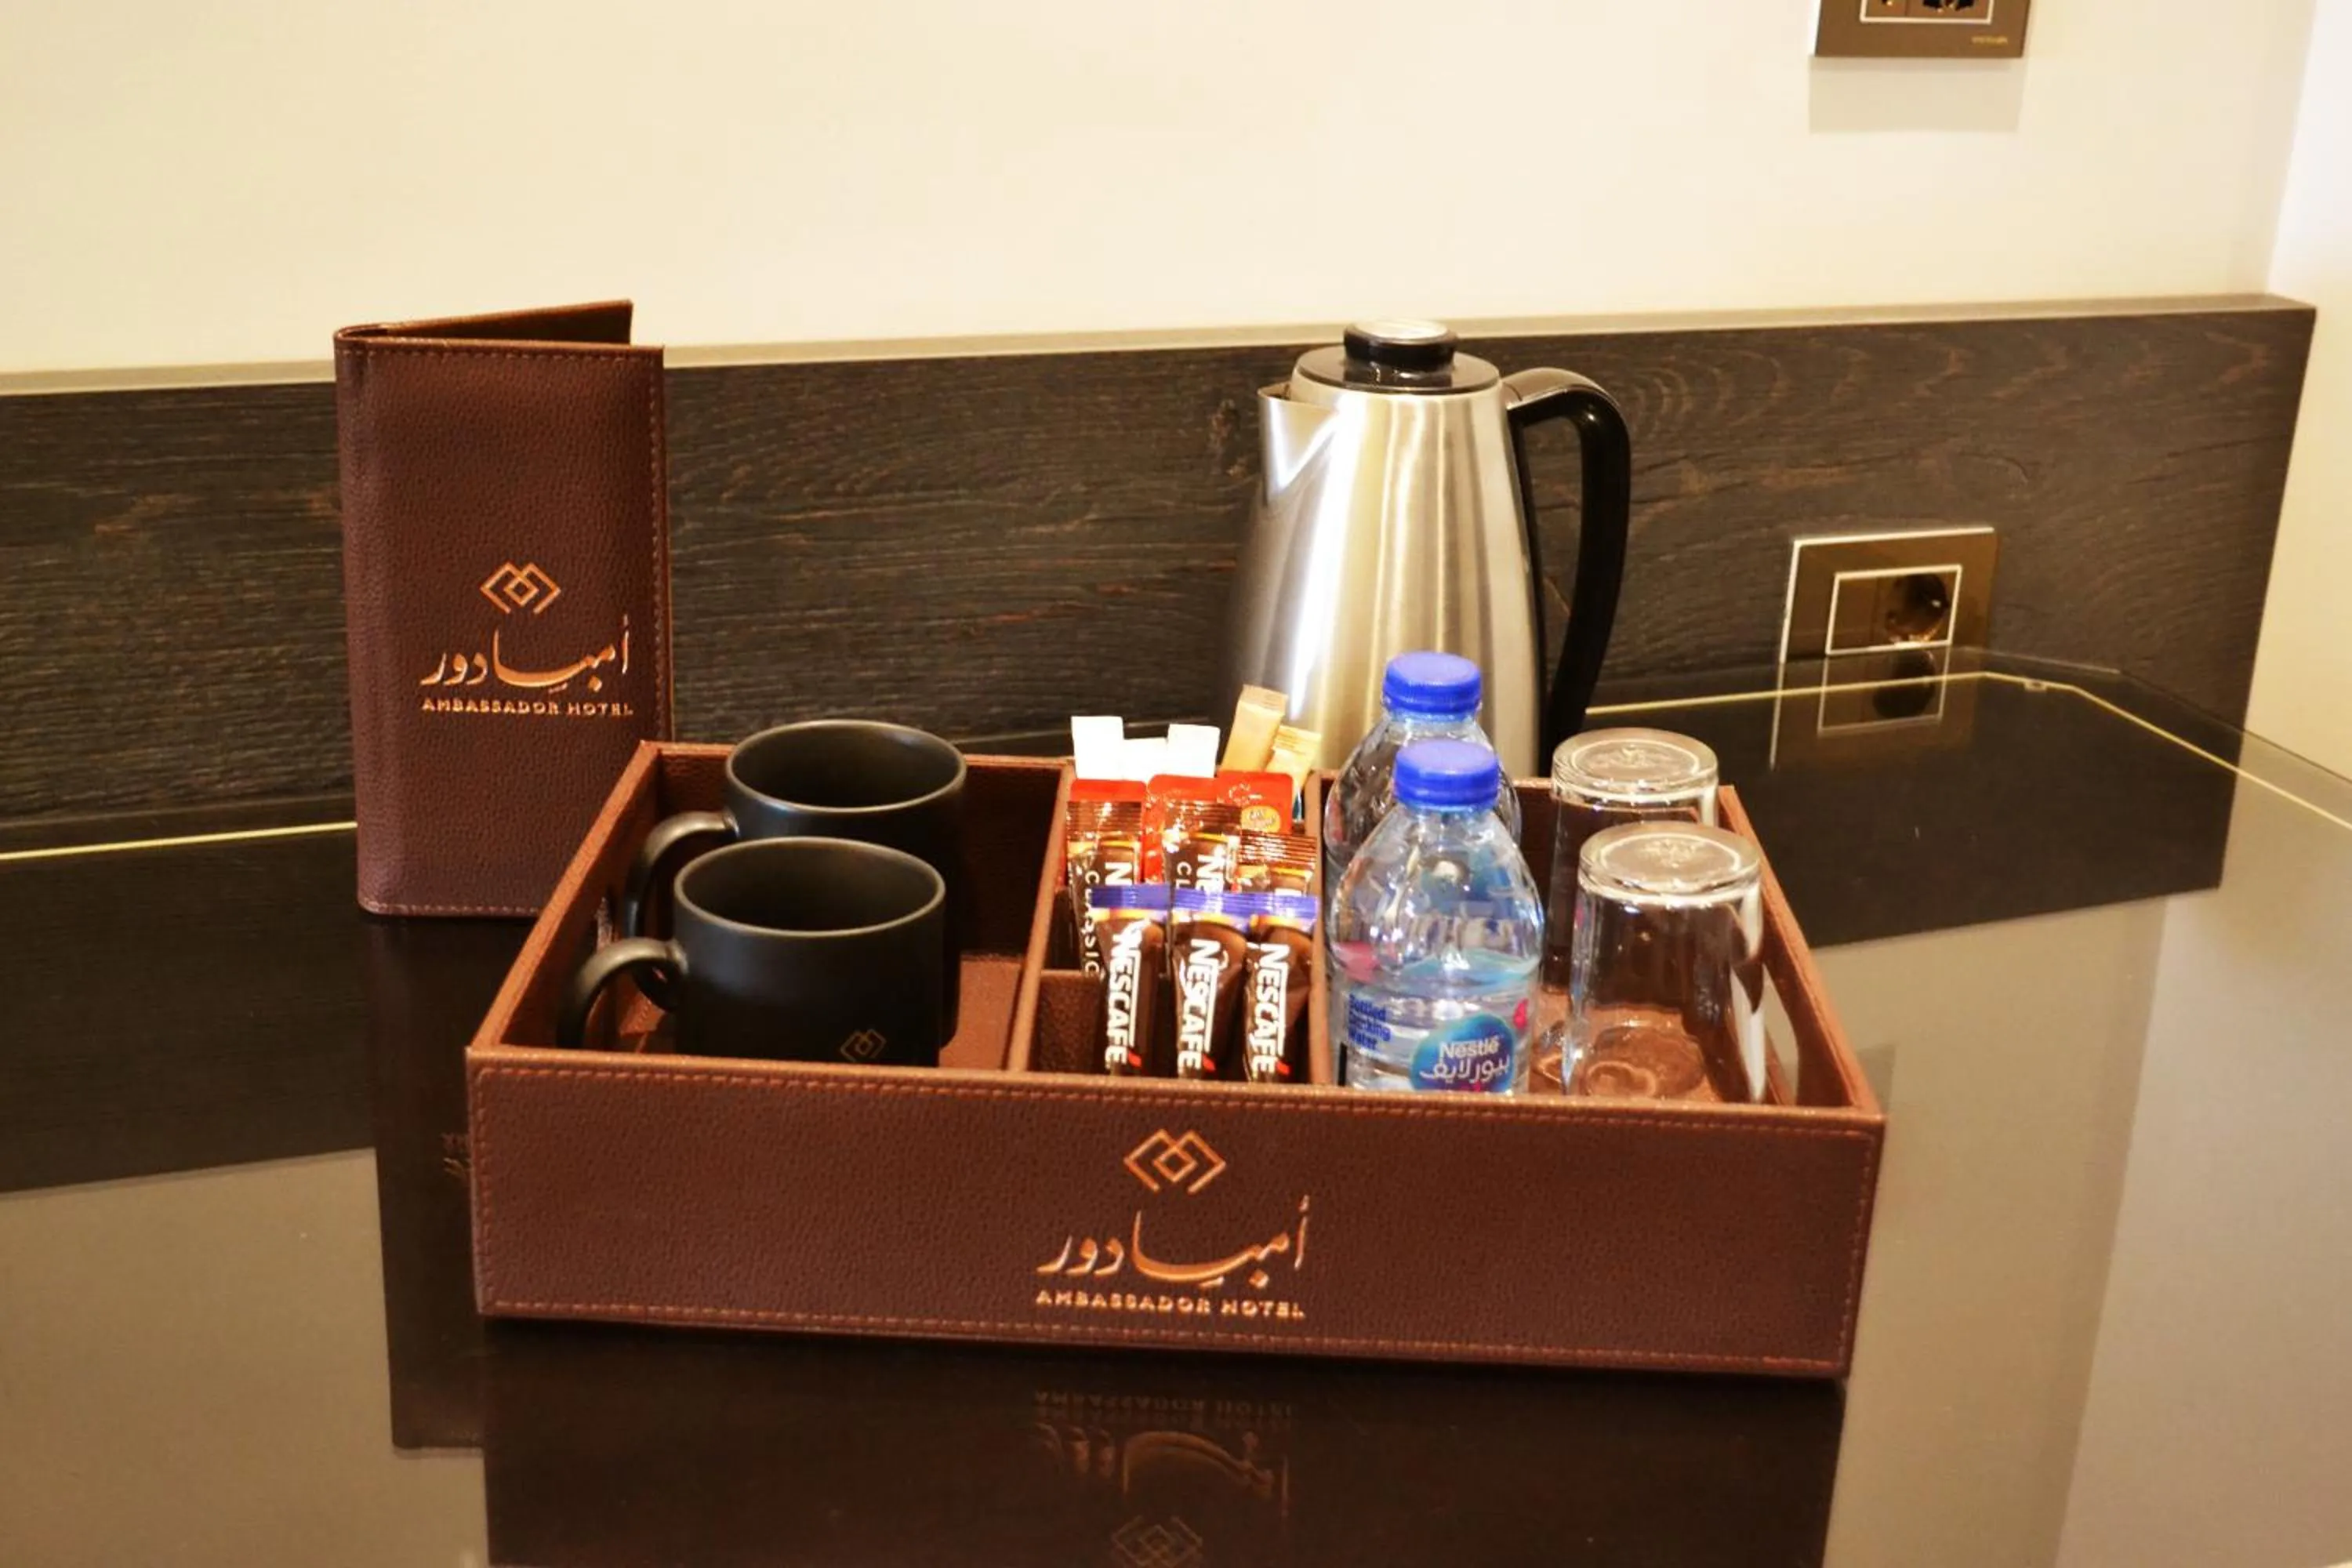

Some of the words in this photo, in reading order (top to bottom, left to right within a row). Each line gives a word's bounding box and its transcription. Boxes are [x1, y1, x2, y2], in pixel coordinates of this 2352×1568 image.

[422, 697, 559, 716] AMBASSADOR
[567, 702, 633, 717] HOTEL
[1036, 1290, 1211, 1315] AMBASSADOR
[1220, 1298, 1306, 1319] HOTEL
